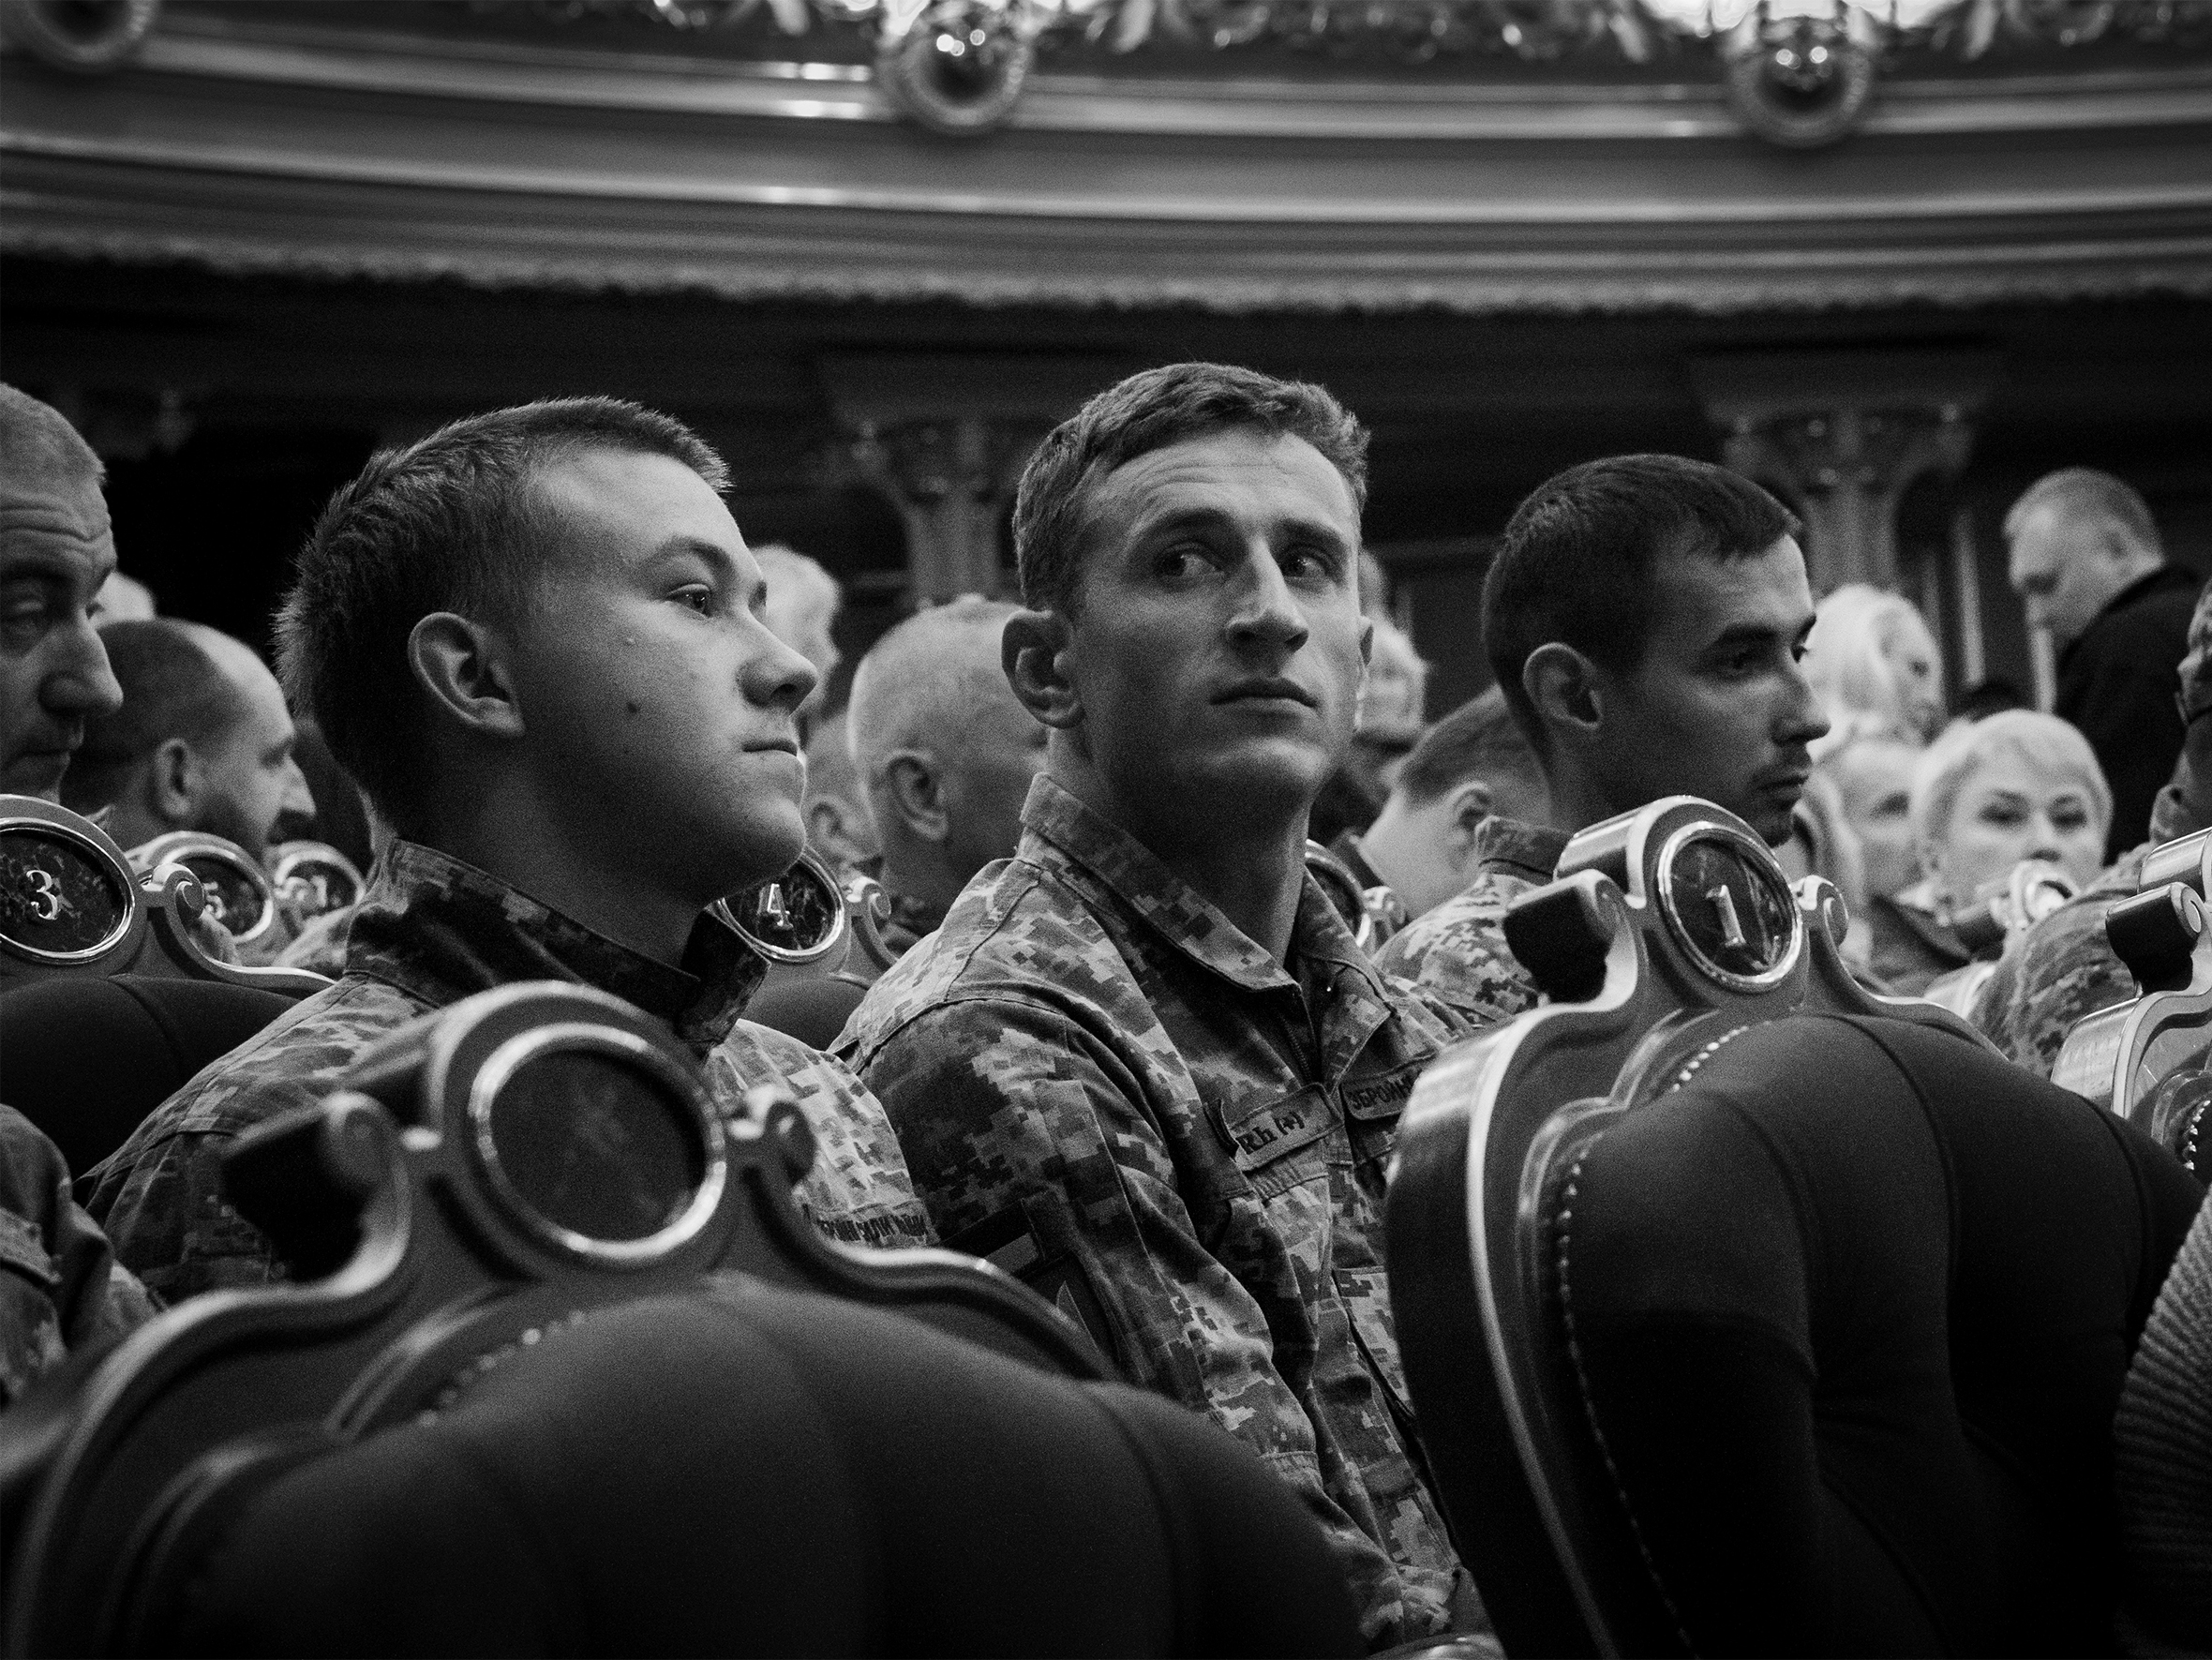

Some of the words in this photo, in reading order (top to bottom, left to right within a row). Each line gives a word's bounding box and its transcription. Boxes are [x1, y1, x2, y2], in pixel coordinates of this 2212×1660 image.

[26, 869, 59, 920] 3
[766, 883, 795, 930] 4
[1705, 884, 1747, 948] 1
[1234, 1126, 1278, 1156] Rh
